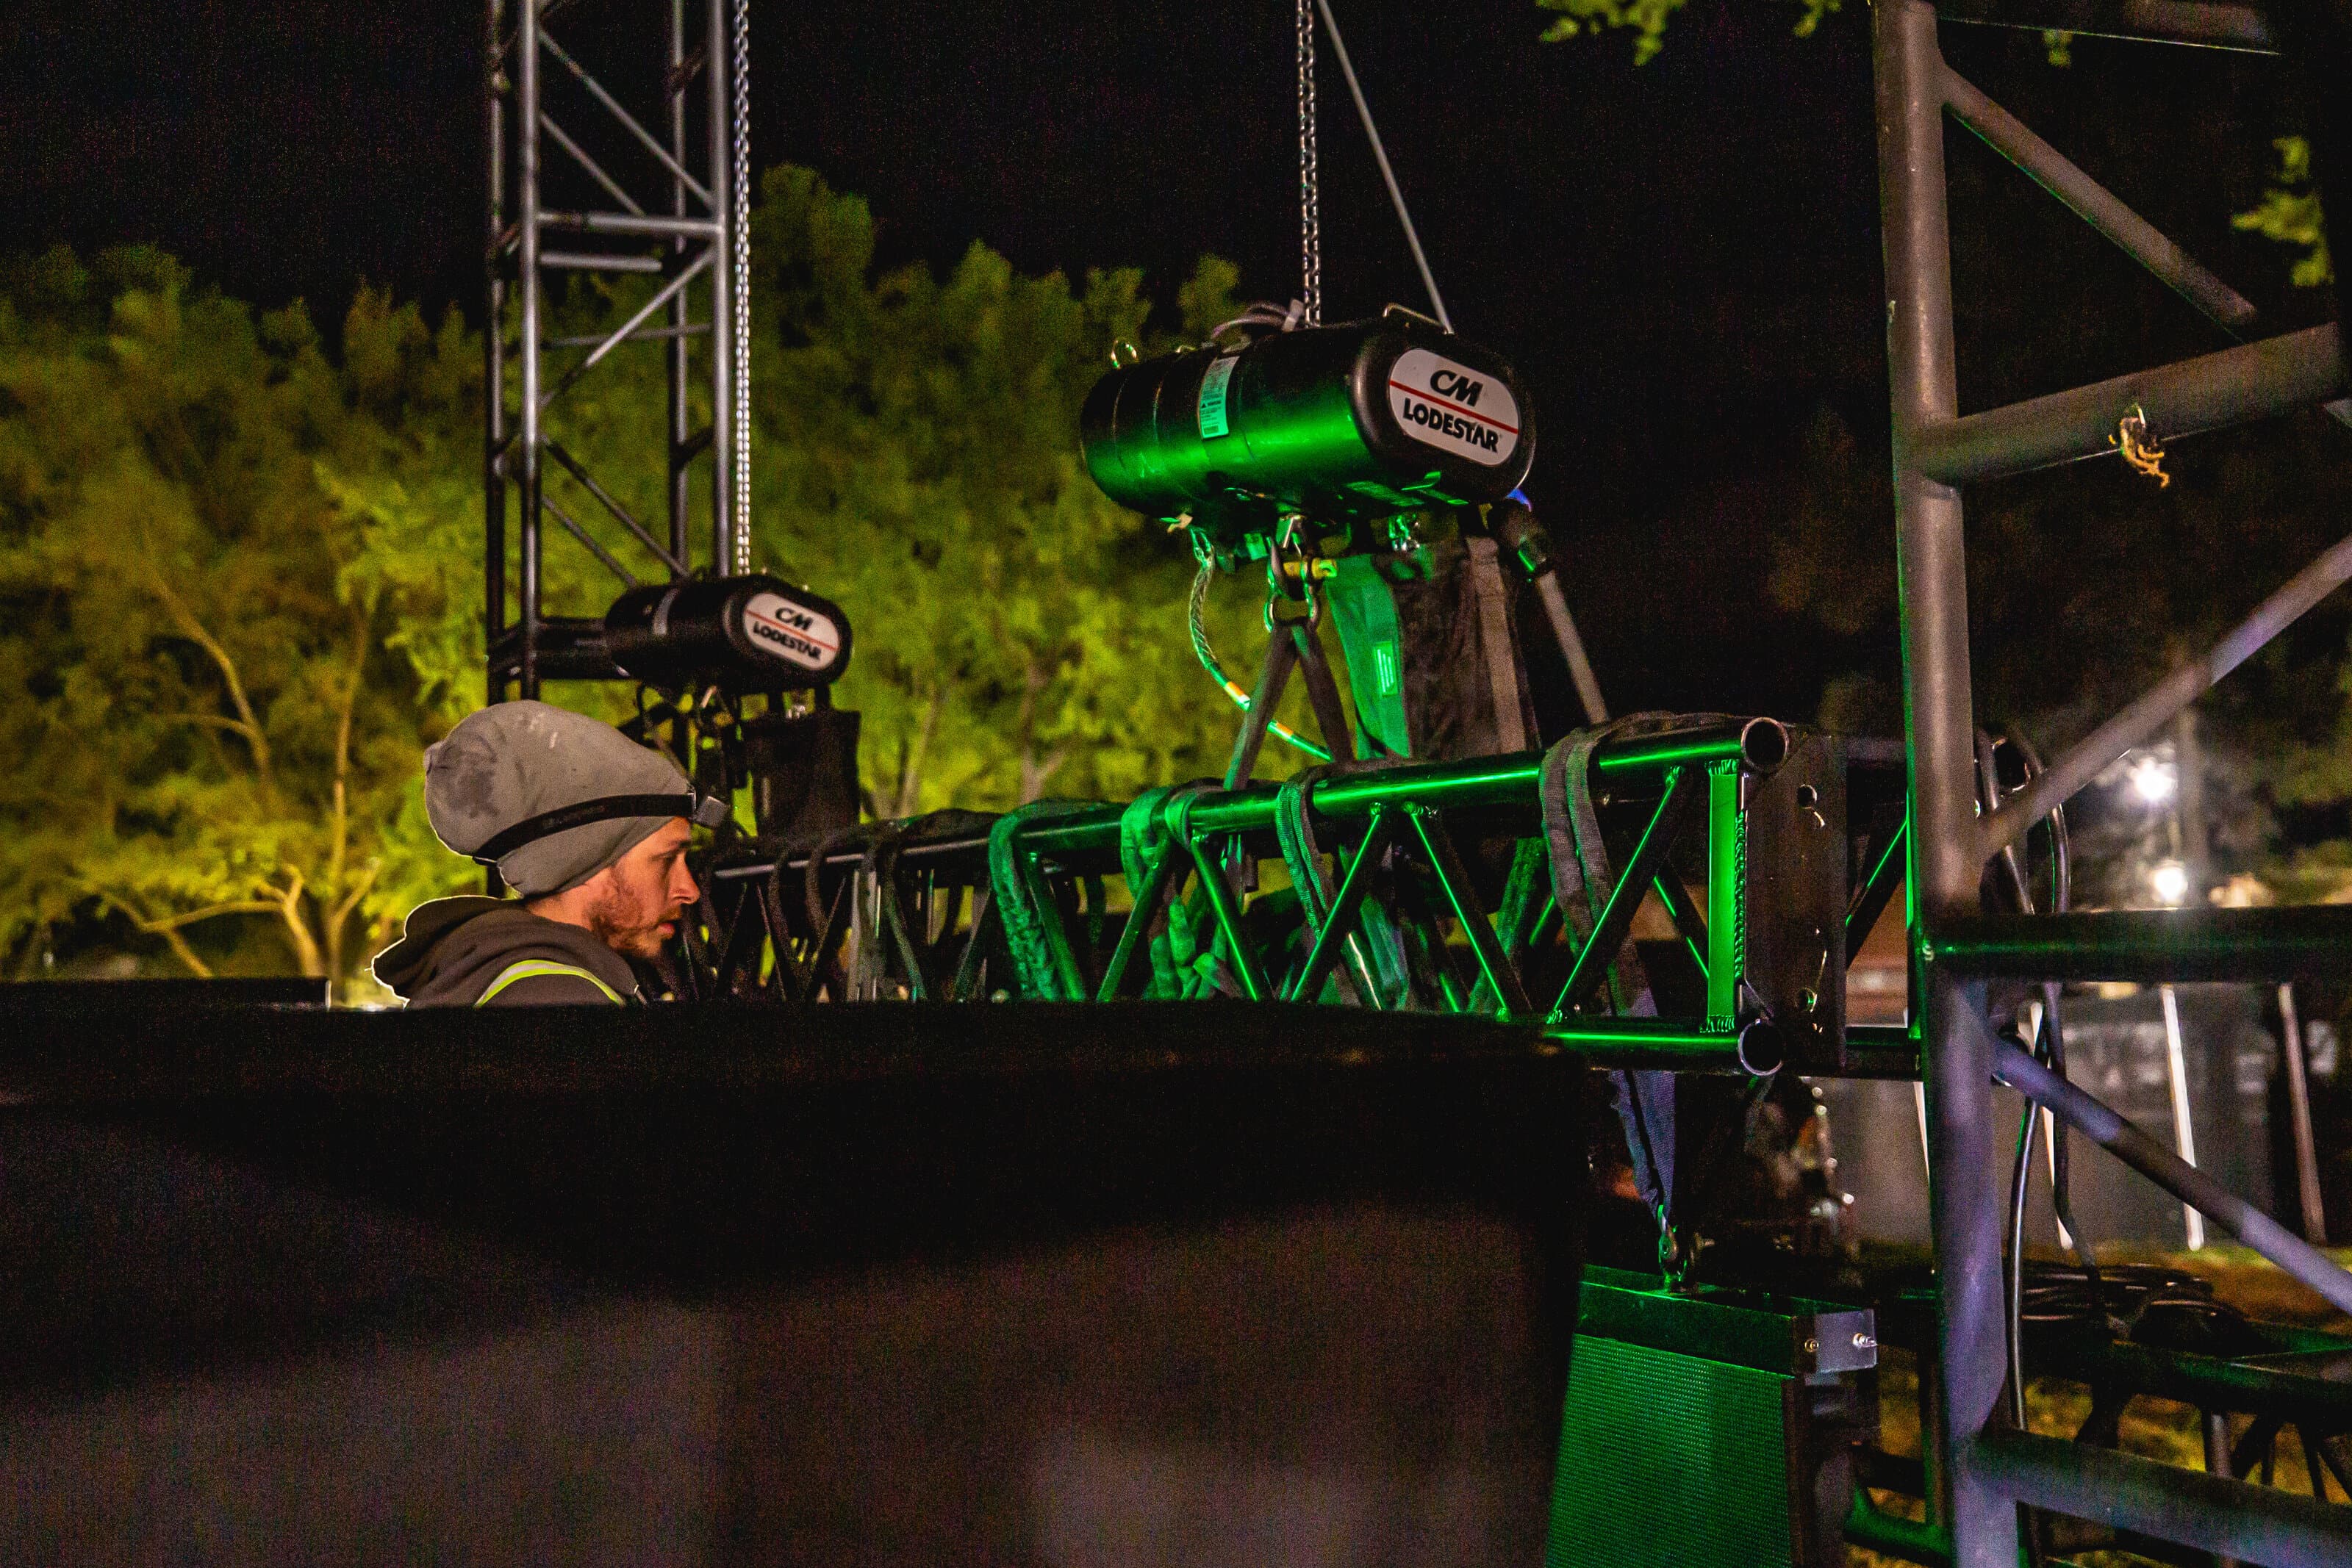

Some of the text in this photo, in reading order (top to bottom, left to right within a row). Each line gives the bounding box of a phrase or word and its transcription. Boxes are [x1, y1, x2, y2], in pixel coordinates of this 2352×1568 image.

[1430, 370, 1484, 407] CM
[1402, 398, 1499, 453] LODESTAR
[775, 607, 814, 630] CM
[753, 620, 821, 660] LODESTAR
